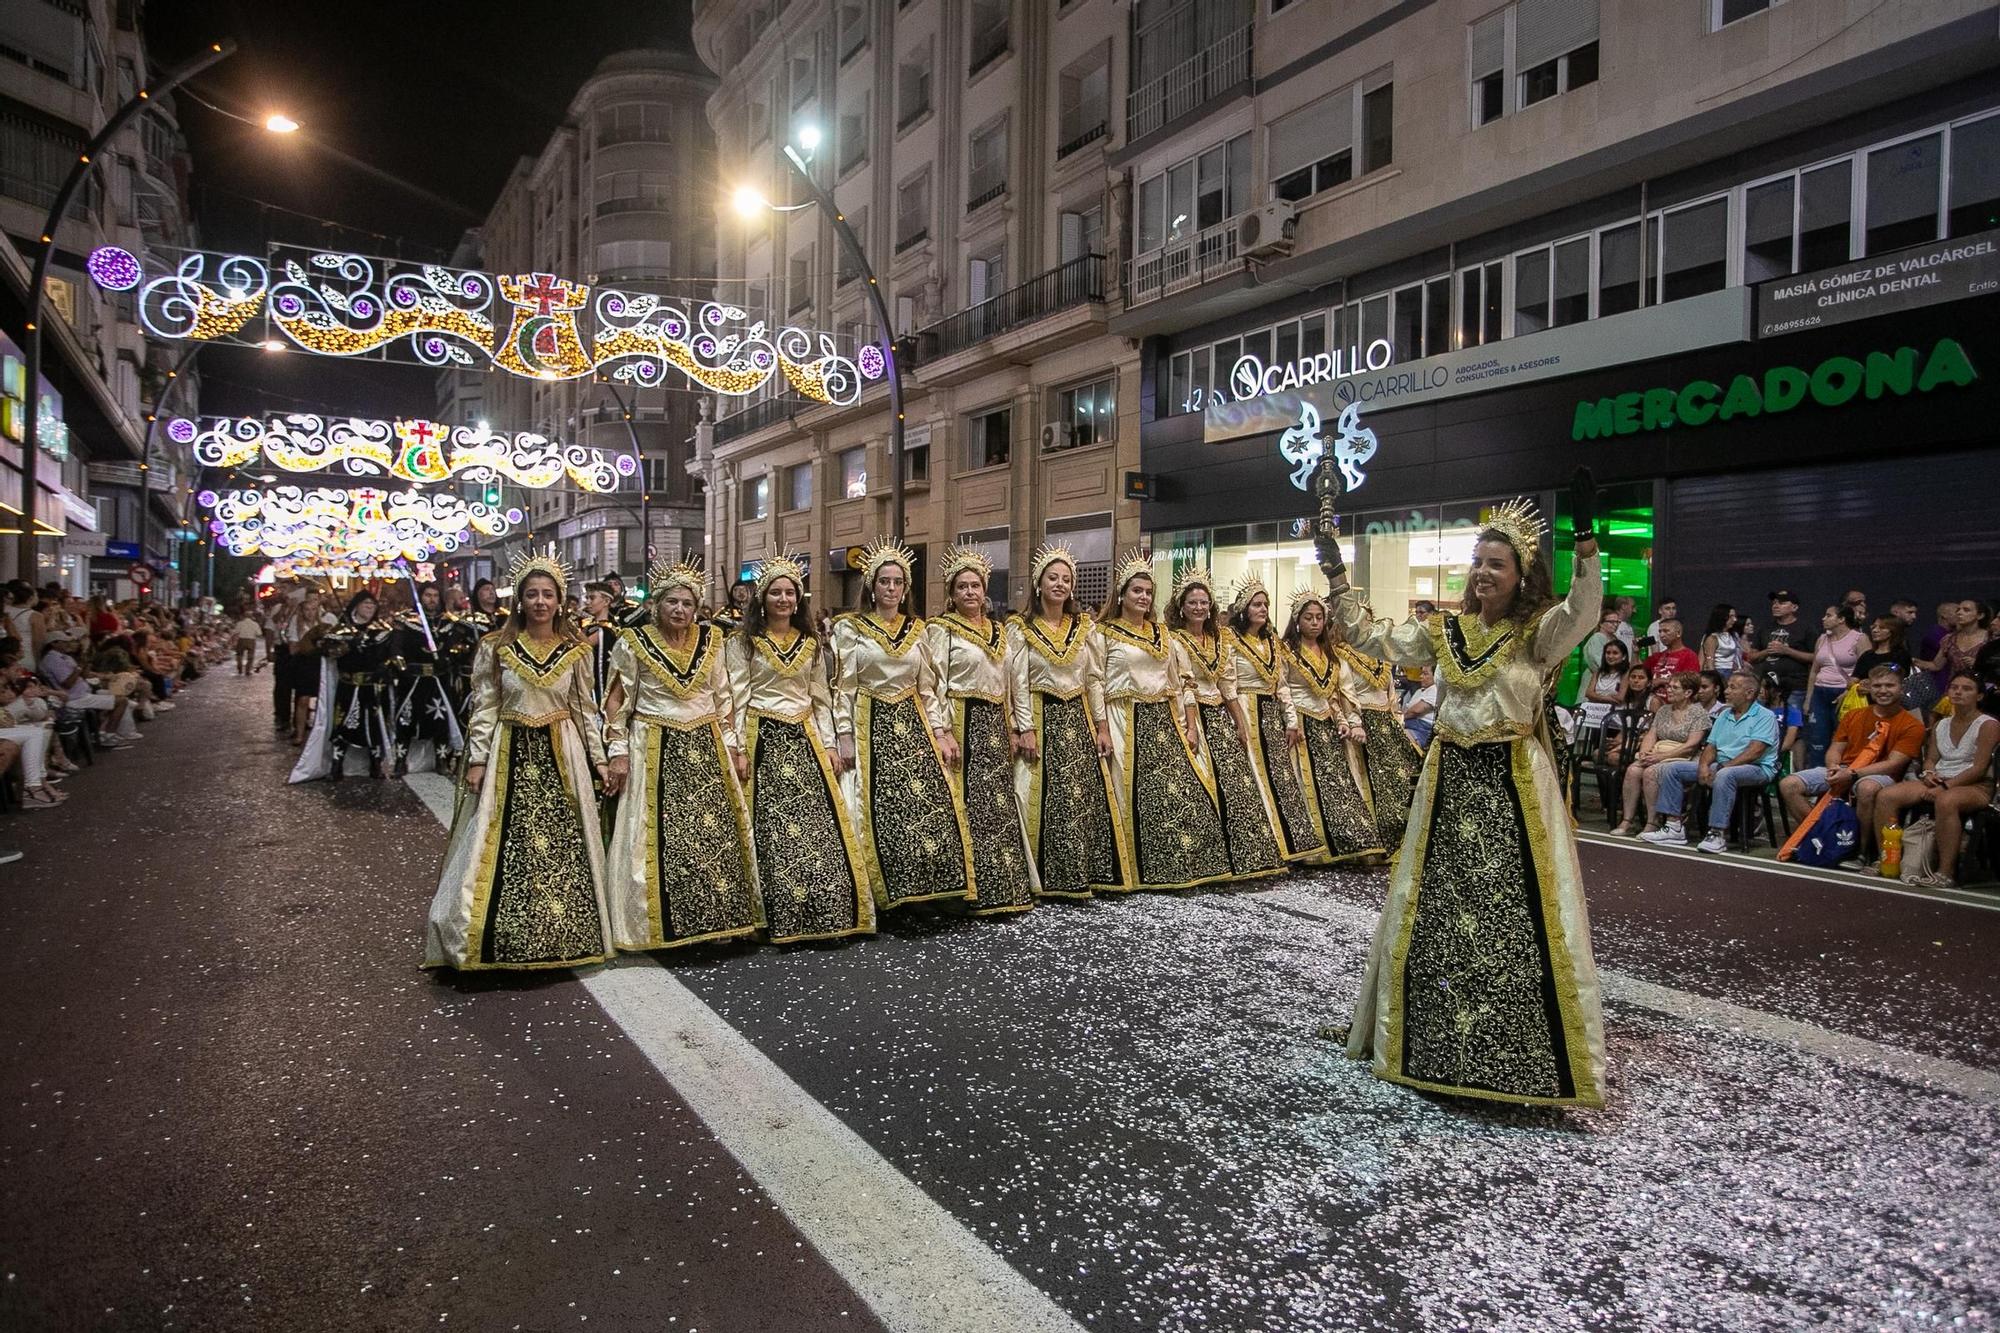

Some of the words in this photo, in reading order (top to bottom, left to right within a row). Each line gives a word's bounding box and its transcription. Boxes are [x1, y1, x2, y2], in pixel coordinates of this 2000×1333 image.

[1774, 280, 1817, 300] MASIÁ
[1820, 270, 1872, 291] GÓMEZ
[1875, 264, 1897, 279] DE
[1899, 241, 1997, 273] VALCÁRCEL
[1817, 289, 1876, 308] CLÍNICA
[1880, 272, 1941, 295] DENTAL
[1773, 316, 1821, 332] 868955626
[1262, 339, 1392, 395] CARRILLO
[1359, 366, 1449, 402] CARRILLO
[1455, 366, 1510, 384] CONSULTORES
[1518, 355, 1561, 371] ASESORES
[1572, 338, 1978, 441] MERCADONA
